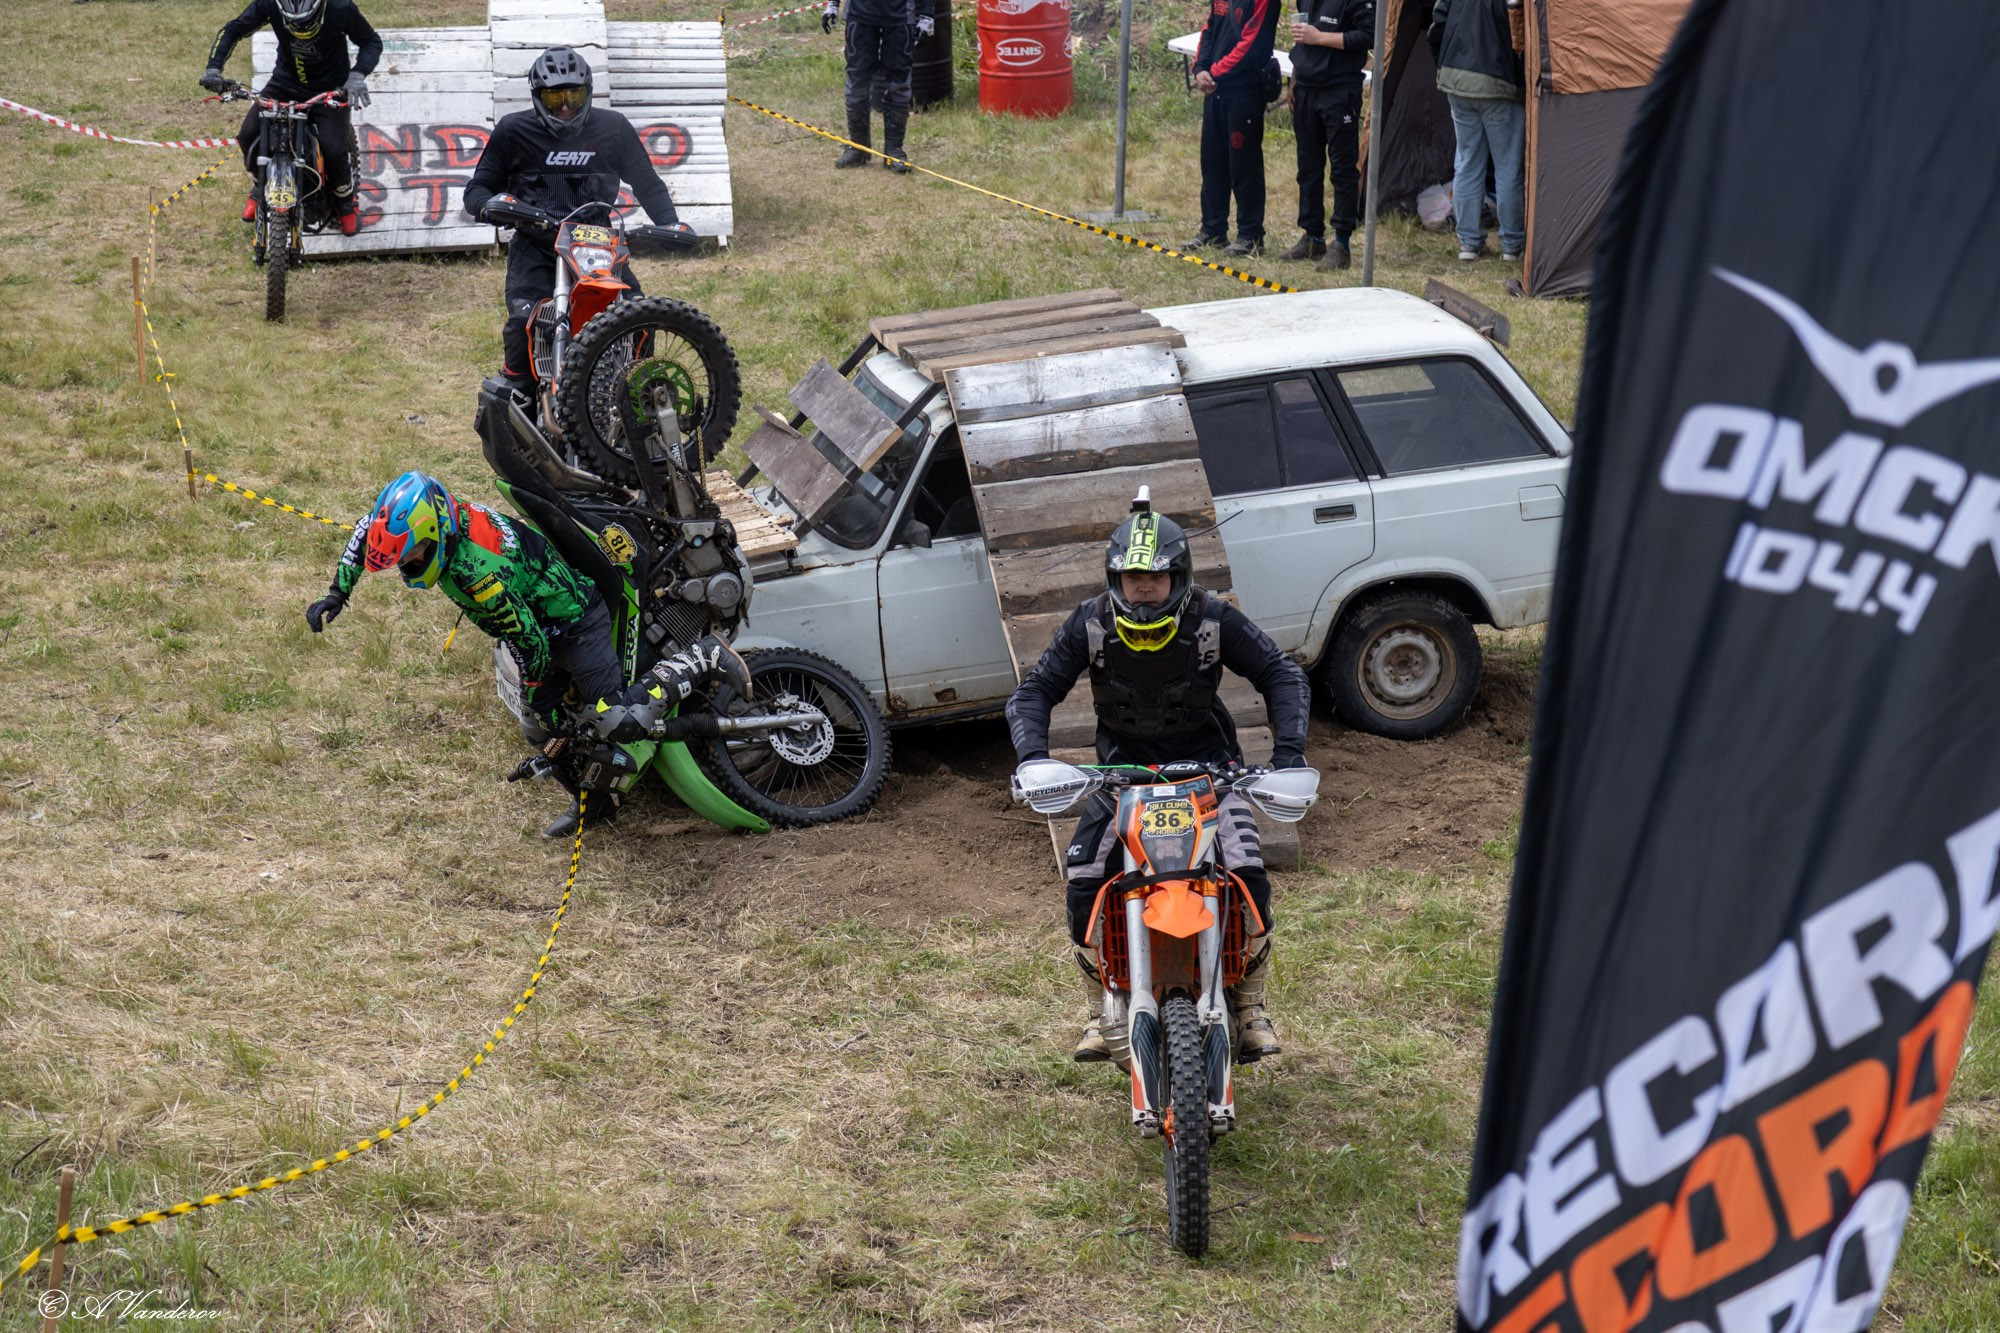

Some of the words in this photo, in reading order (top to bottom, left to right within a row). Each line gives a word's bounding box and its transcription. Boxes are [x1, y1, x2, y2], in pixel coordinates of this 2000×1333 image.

[997, 46, 1042, 56] SINTEC
[545, 151, 596, 166] LEATT
[274, 193, 289, 203] 45
[582, 230, 602, 240] 82
[1724, 522, 1937, 634] 104.4
[1149, 803, 1165, 811] HILL
[1155, 812, 1181, 828] 86
